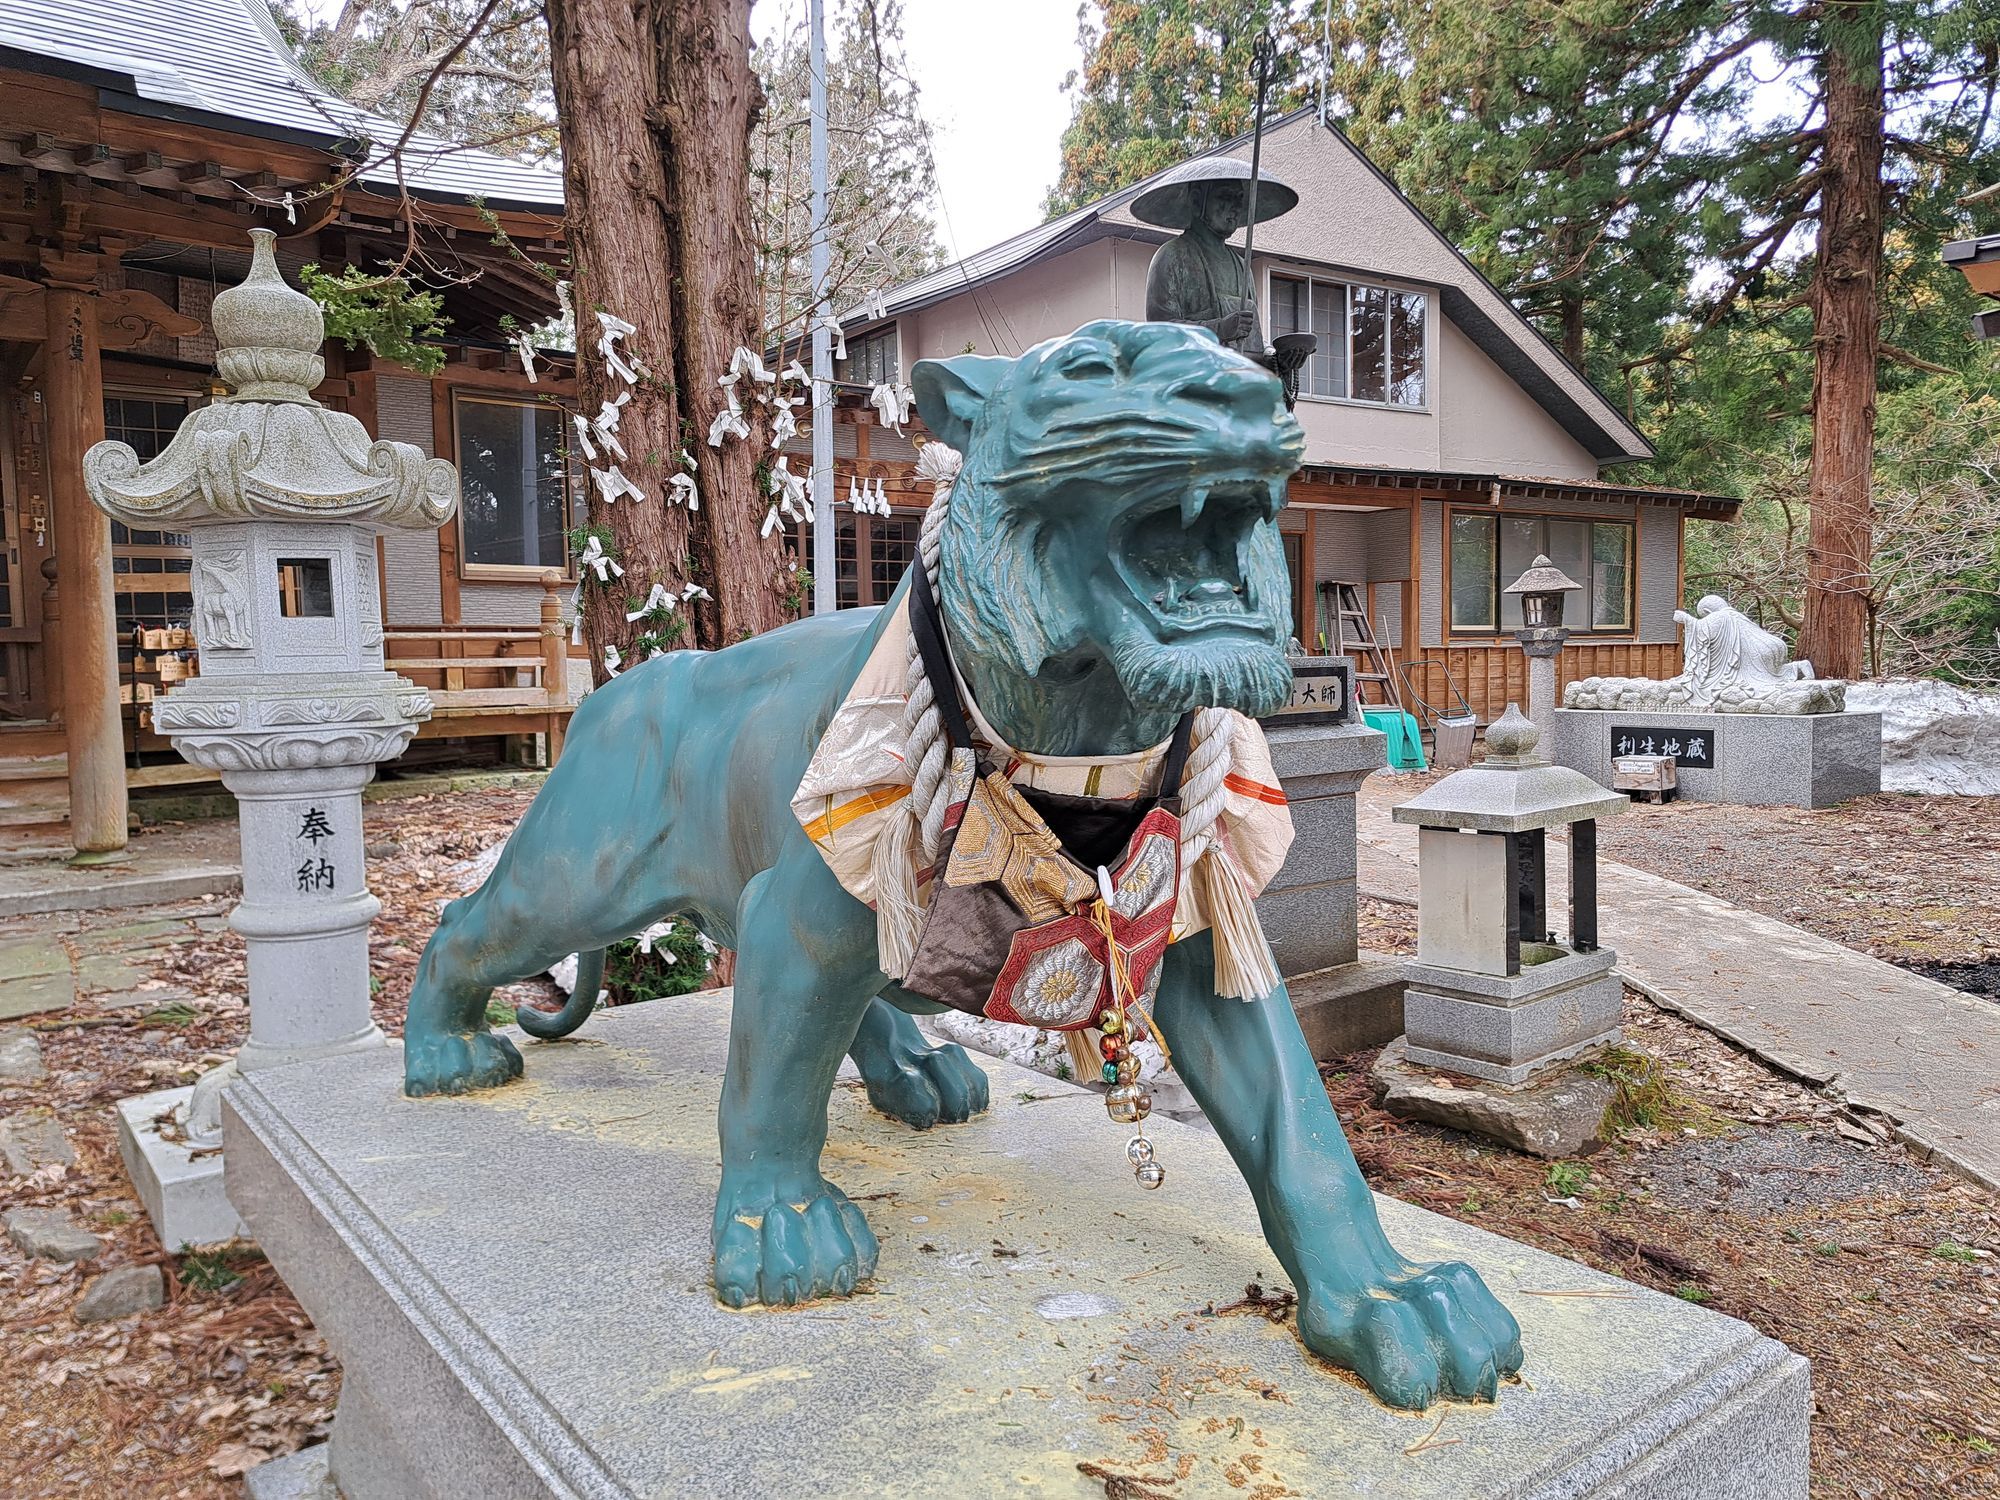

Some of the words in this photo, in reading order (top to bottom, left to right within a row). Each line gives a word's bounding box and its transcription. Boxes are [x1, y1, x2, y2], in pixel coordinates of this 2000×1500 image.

[1617, 735, 1706, 760] 利生地蔵
[296, 807, 335, 892] 奉納
